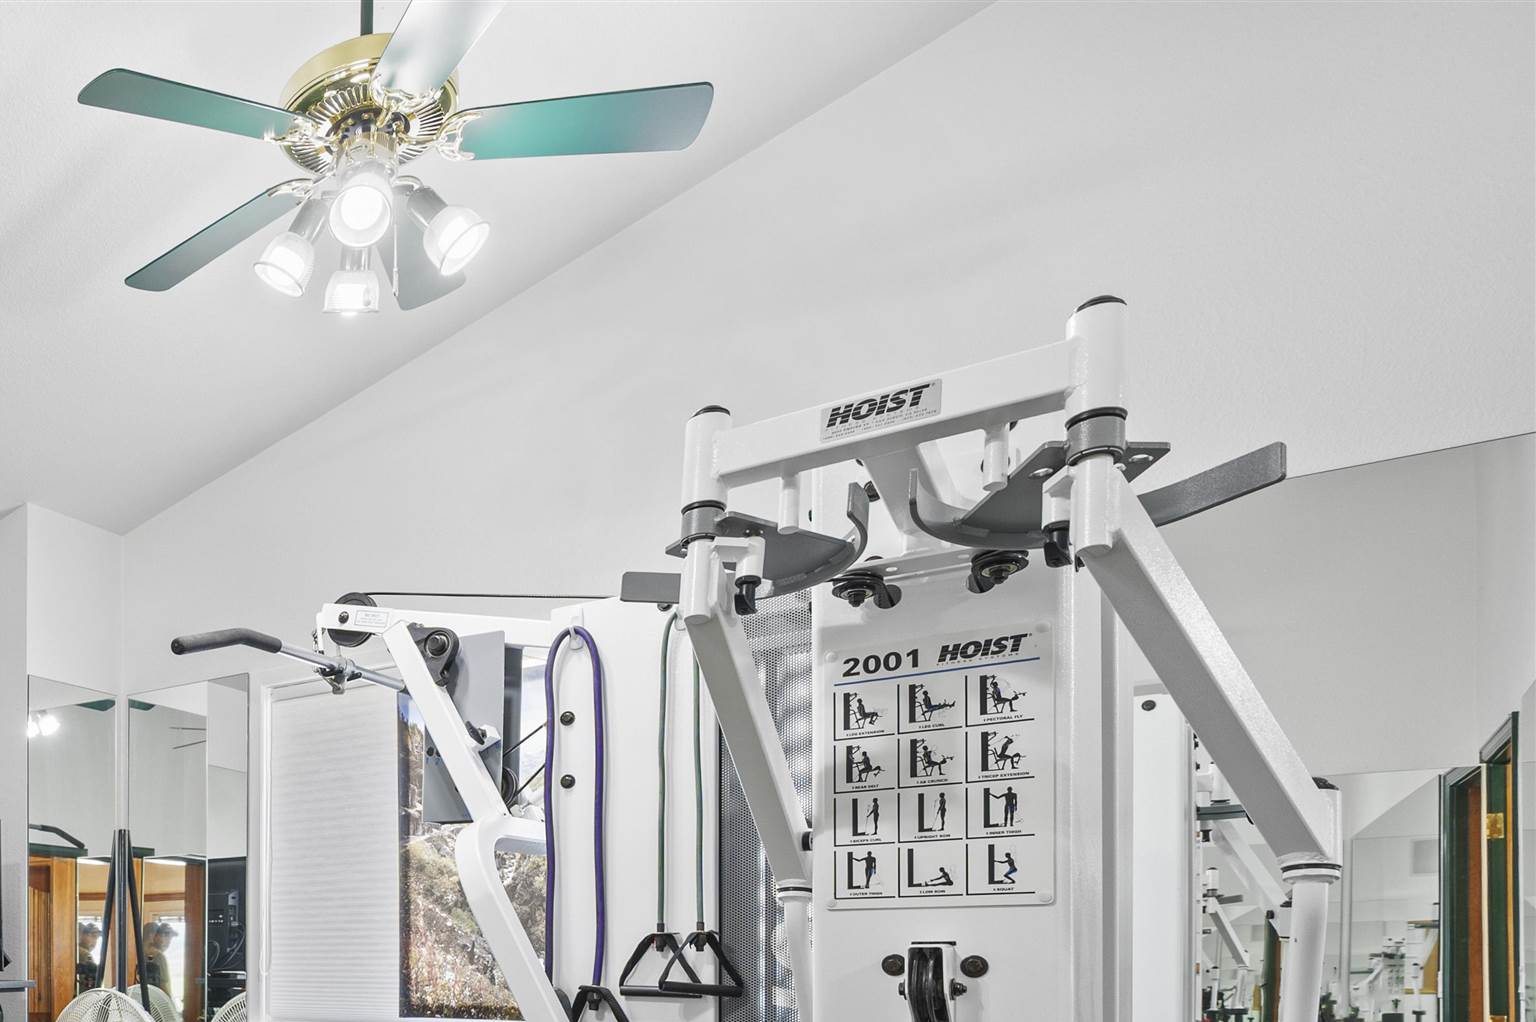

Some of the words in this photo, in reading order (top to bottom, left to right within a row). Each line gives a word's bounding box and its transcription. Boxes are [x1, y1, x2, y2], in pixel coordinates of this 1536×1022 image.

[826, 383, 930, 428] HOIST
[843, 649, 919, 677] 2001
[937, 633, 1028, 662] HOIST
